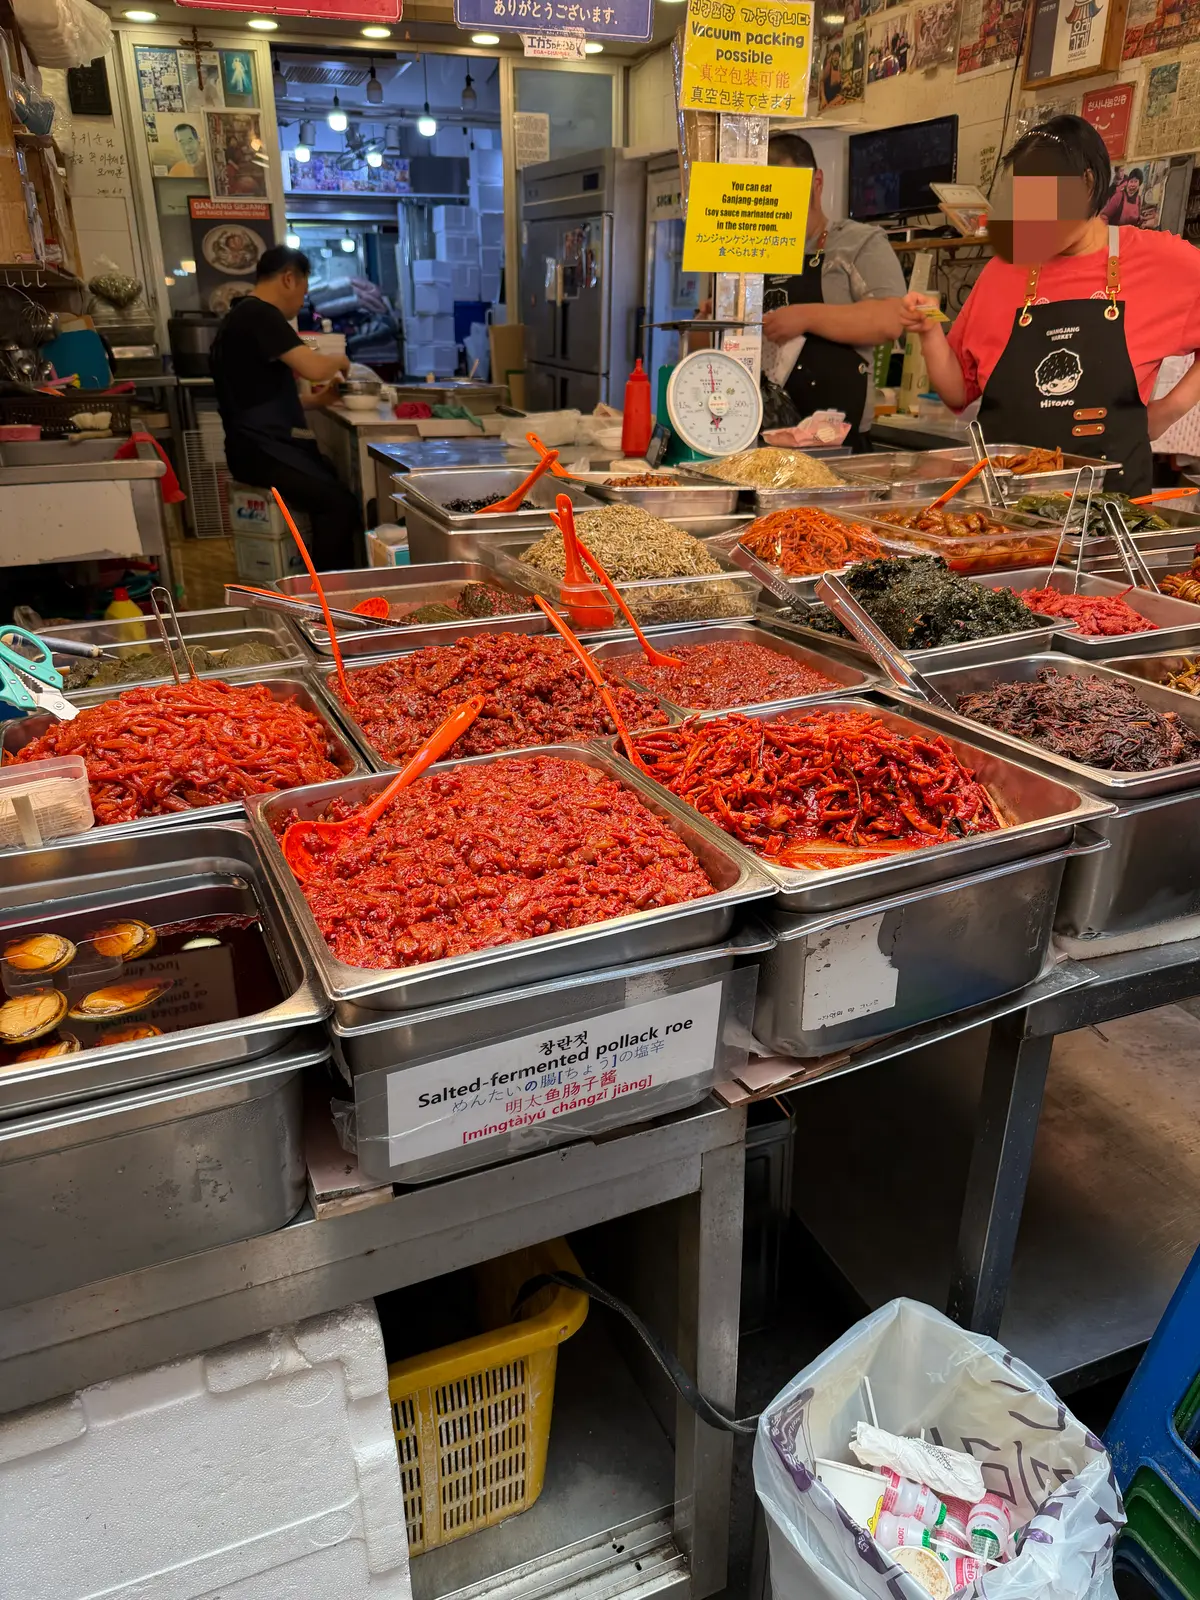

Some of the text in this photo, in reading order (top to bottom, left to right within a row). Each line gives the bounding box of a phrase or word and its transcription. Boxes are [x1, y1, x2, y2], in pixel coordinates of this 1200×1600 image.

[741, 8, 811, 27] 가능합니다
[691, 21, 805, 48] Vacuum packing
[716, 49, 773, 65] possible
[700, 64, 790, 89] 真空包装可能
[690, 86, 796, 111] 真空包装できます
[731, 181, 772, 192] You can eat
[722, 194, 779, 207] Ganjang-gejang
[705, 207, 793, 220] (soy sauce marinated crab)
[717, 221, 778, 232] in the store room.
[695, 233, 797, 247] カンジャンケジャンが店内で
[718, 246, 770, 259] 食べられます。
[538, 1031, 588, 1056] 창란젓
[418, 1019, 693, 1109] Salted-fermented pollack roe
[505, 1069, 617, 1115] 明太鱼肠子酱
[462, 1108, 546, 1144] [míngtàiyú
[611, 1075, 653, 1099] jiàng]
